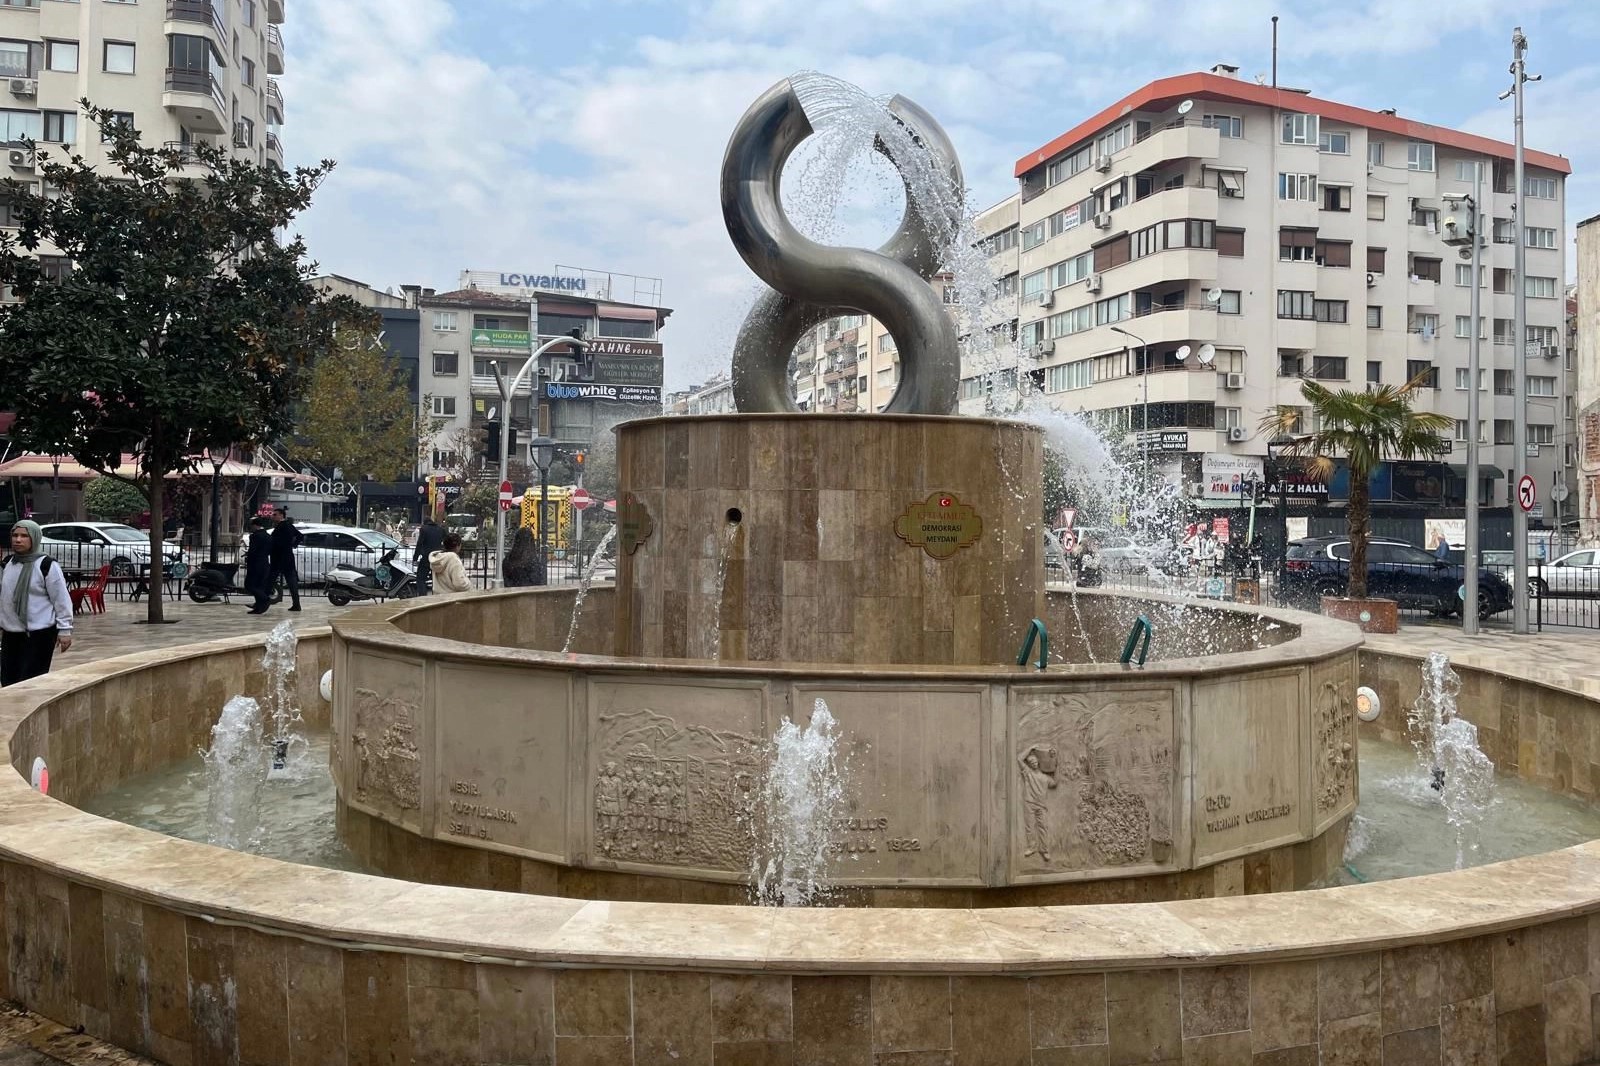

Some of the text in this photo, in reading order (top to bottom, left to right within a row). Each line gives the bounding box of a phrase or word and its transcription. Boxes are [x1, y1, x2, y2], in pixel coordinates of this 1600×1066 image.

[500, 273, 520, 286] LC
[622, 387, 650, 395] Epilasyon
[1163, 434, 1187, 442] AVUKAT
[294, 478, 358, 495] addax
[1211, 483, 1229, 493] ATOM
[1269, 482, 1328, 493] AZ HALİL
[926, 535, 958, 543] MEYDANI
[886, 838, 921, 852] 1922
